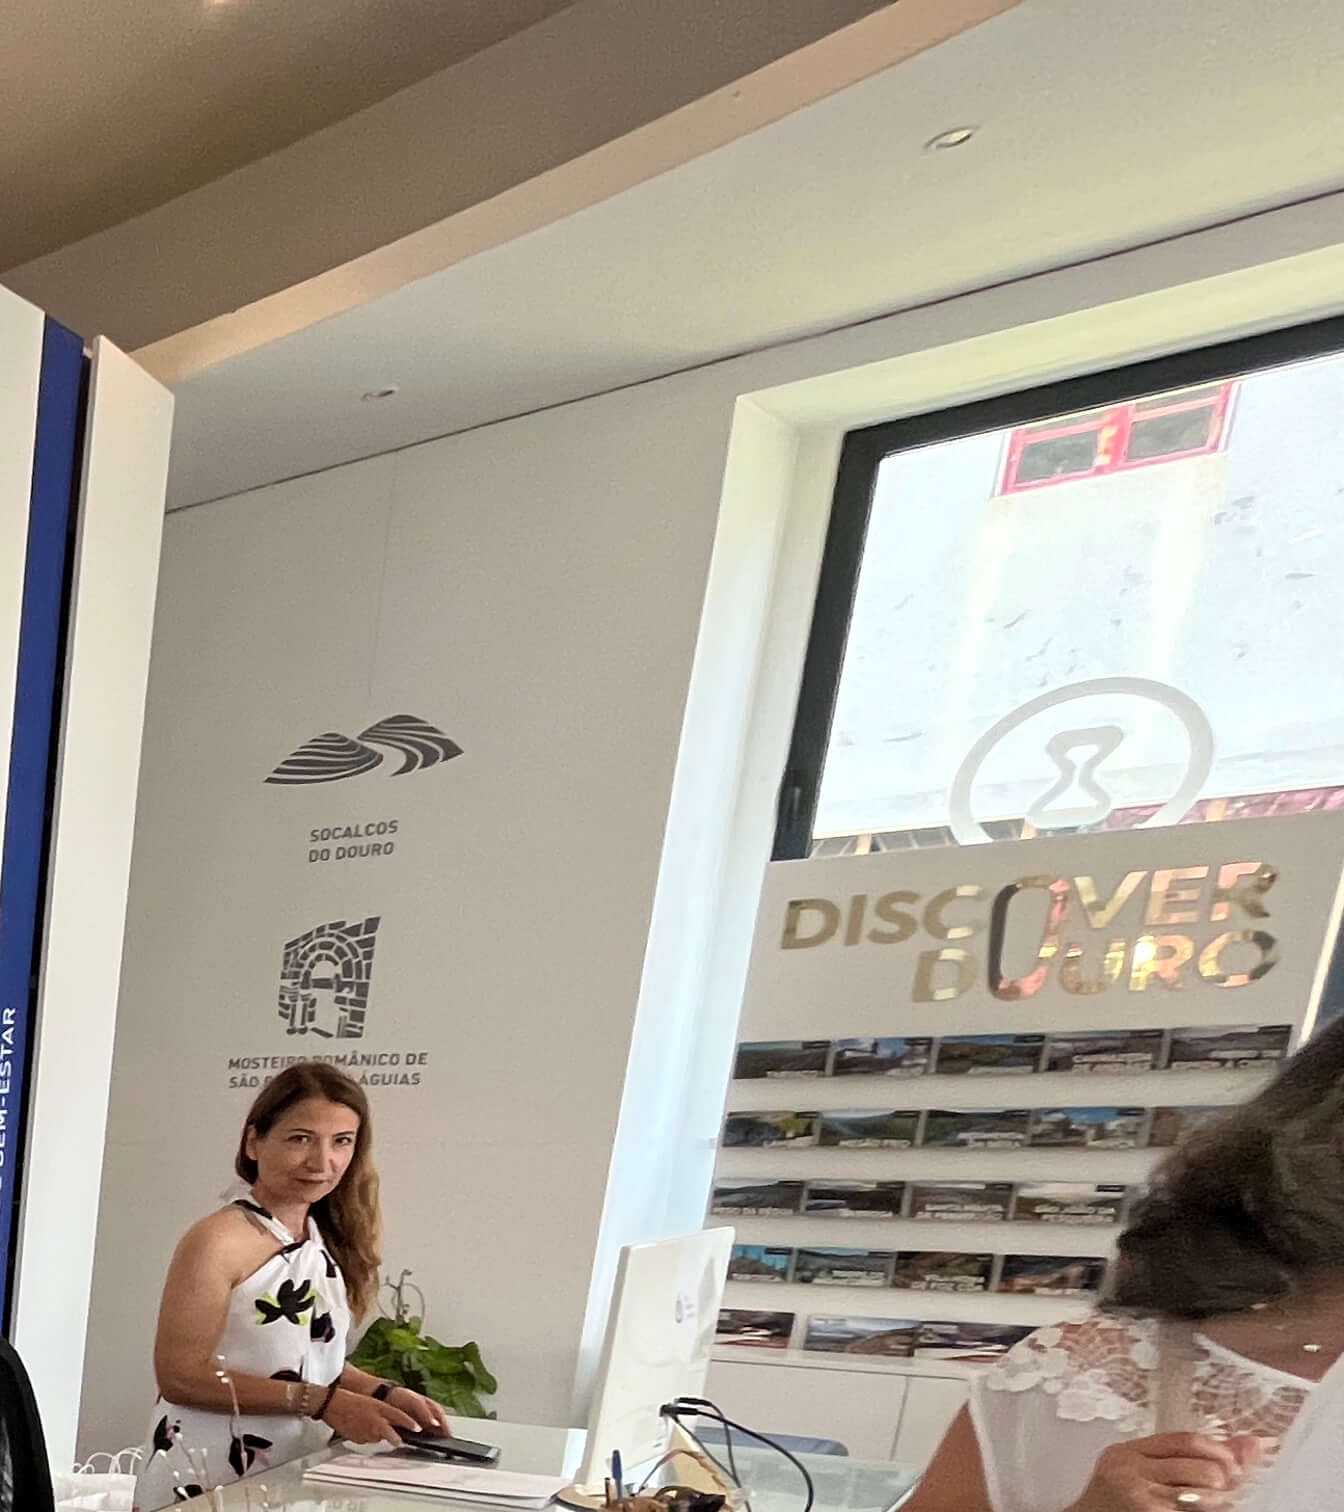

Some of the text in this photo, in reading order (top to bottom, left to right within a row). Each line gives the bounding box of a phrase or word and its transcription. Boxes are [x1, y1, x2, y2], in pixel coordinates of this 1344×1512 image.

[309, 820, 399, 842] SOCALCOS
[308, 842, 395, 863] DO DOURO
[780, 861, 1279, 964] DISCOVER
[405, 1052, 428, 1065] DE
[228, 1073, 260, 1089] SÃO
